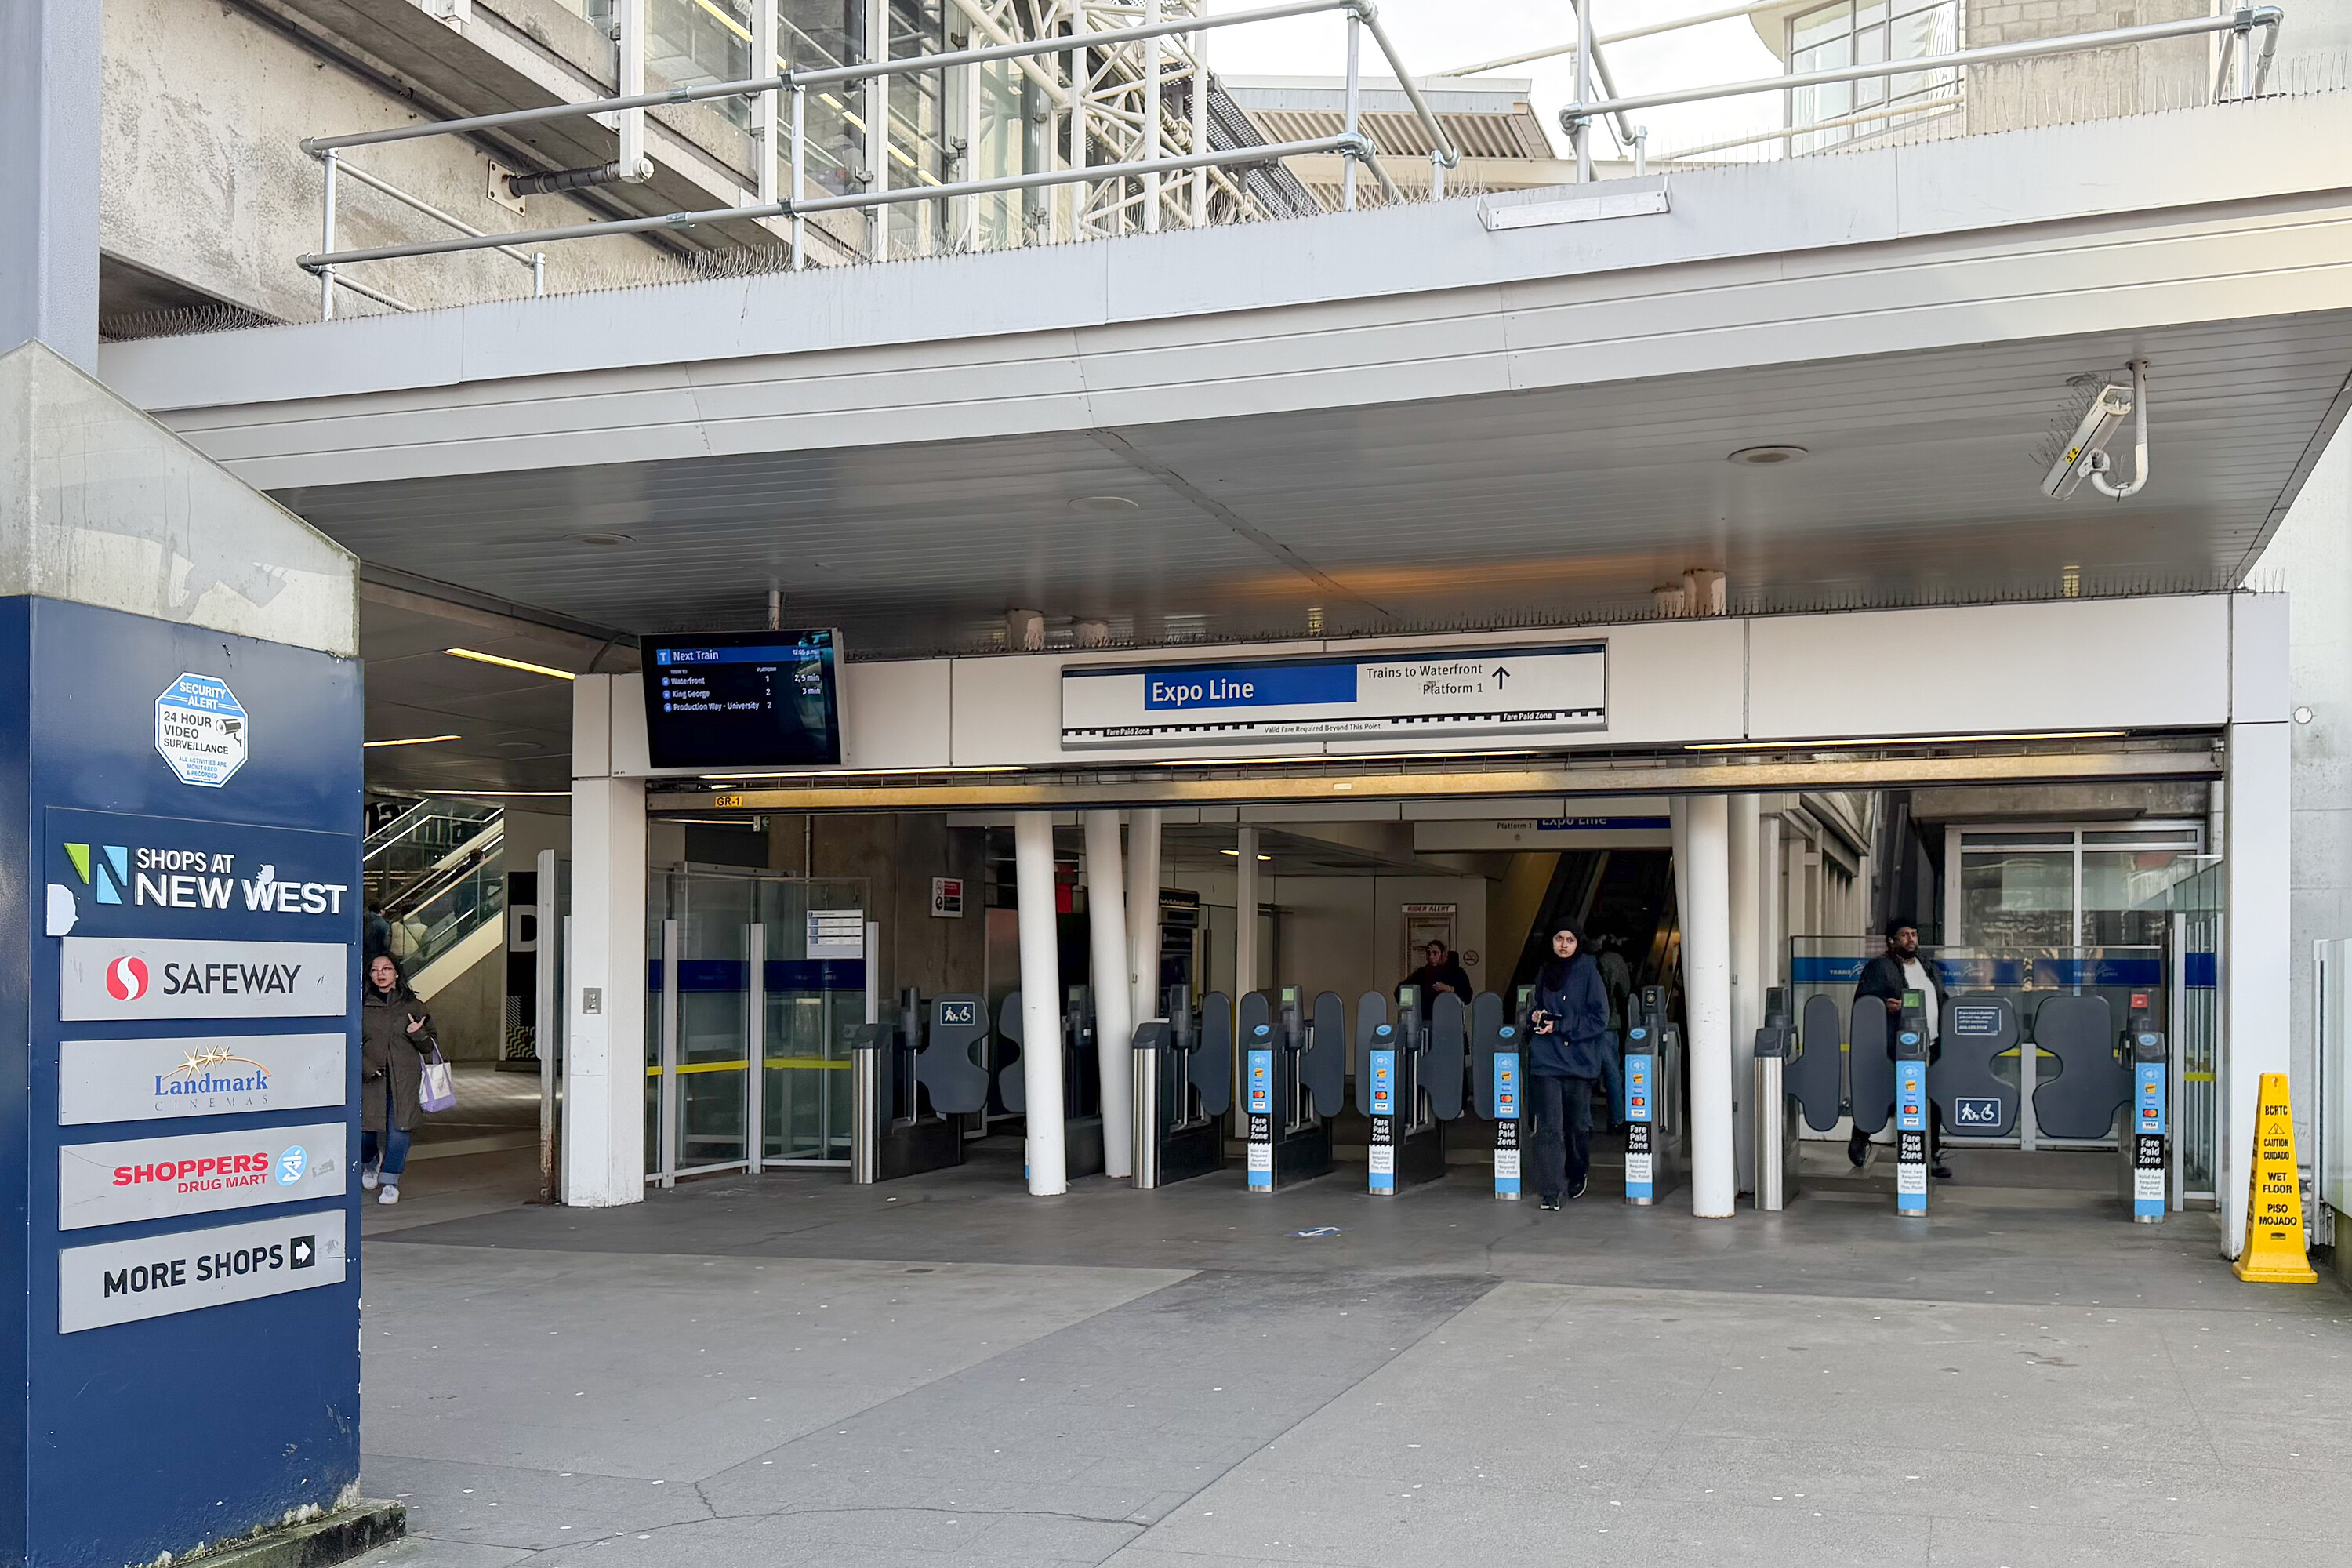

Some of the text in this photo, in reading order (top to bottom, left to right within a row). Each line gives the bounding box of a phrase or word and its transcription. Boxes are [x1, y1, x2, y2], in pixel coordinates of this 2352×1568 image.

[673, 651, 695, 661] Next
[696, 650, 719, 660] Train
[1367, 663, 1483, 679] Trains to Waterfront
[180, 681, 226, 699] SECURITY
[1152, 679, 1254, 706] Expo Line
[1423, 682, 1483, 695] Platform 1
[673, 690, 710, 699] King George
[188, 695, 218, 710] ALERT
[673, 702, 708, 711] Production
[709, 702, 722, 711] Way
[728, 701, 760, 710] University
[164, 711, 212, 728] 24 HOUR
[164, 724, 199, 739] VIDEO
[1107, 728, 1120, 737] Fare
[1121, 728, 1134, 736] Paid
[1296, 724, 1323, 733] Required
[163, 738, 229, 755] SURVEILLANCE
[189, 757, 216, 766] ACTIVITIES
[187, 764, 218, 772] MONITORED
[191, 770, 218, 779] RECORDED
[717, 797, 740, 807] GR-1
[136, 848, 235, 874] SHOPS AT
[135, 873, 347, 915] NEW WEST
[163, 963, 302, 995] SAFEWAY
[155, 1071, 269, 1097] Landmark
[155, 1094, 269, 1112] CINEMAS
[2265, 1105, 2288, 1116] BCRTC
[1499, 1121, 1515, 1130] Fare
[1631, 1124, 1647, 1134] Fare
[1629, 1133, 1647, 1142] Paid
[1902, 1134, 1921, 1142] Fare
[2140, 1138, 2159, 1147] Fare
[2264, 1138, 2289, 1147] CAUTION
[1902, 1142, 1921, 1151] Paid
[2140, 1147, 2160, 1156] Paid
[1901, 1151, 1922, 1160] Zone
[2139, 1156, 2161, 1164] Zone
[2264, 1152, 2289, 1160] CUIDADO
[113, 1152, 269, 1187] SHOPPERS
[2267, 1173, 2288, 1181] WET
[177, 1174, 268, 1194] DRUG MART
[2263, 1185, 2292, 1194] FLOOR
[2267, 1204, 2288, 1214] PISO
[2259, 1217, 2297, 1225] MOJADO
[103, 1244, 284, 1298] MORE SHOPS
